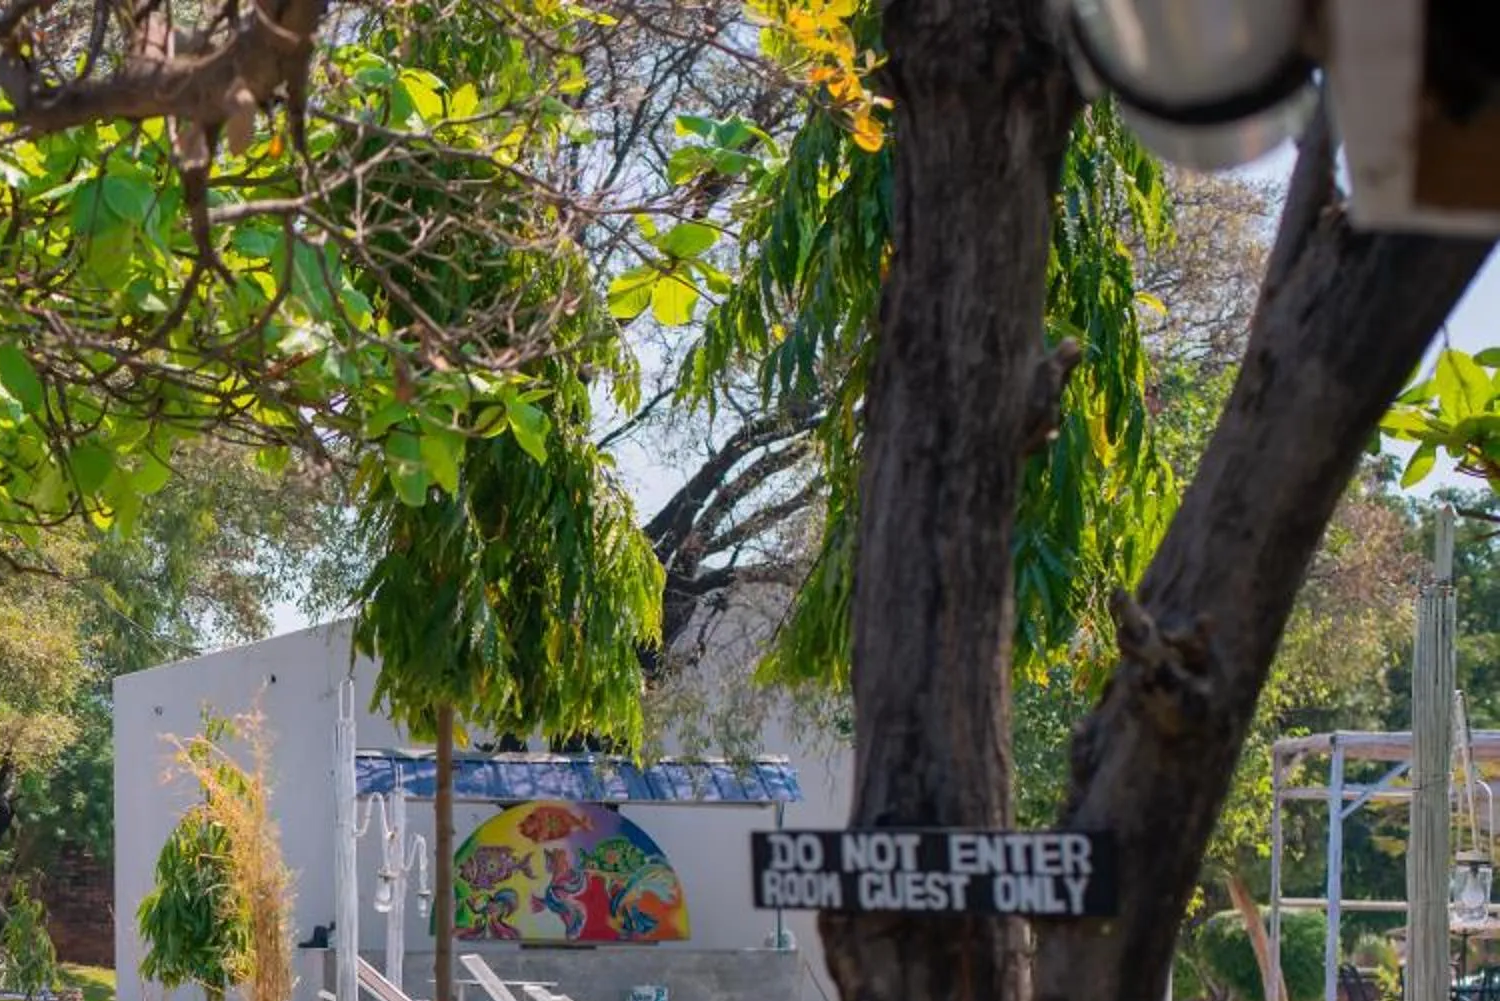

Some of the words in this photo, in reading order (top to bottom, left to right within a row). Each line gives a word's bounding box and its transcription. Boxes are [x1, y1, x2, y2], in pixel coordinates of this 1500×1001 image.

[767, 834, 824, 871] DO
[841, 834, 920, 872] NOT
[948, 833, 1092, 874] ENTER
[761, 870, 841, 908] ROOM
[858, 872, 970, 911] GUEST
[993, 874, 1090, 914] ONLY
